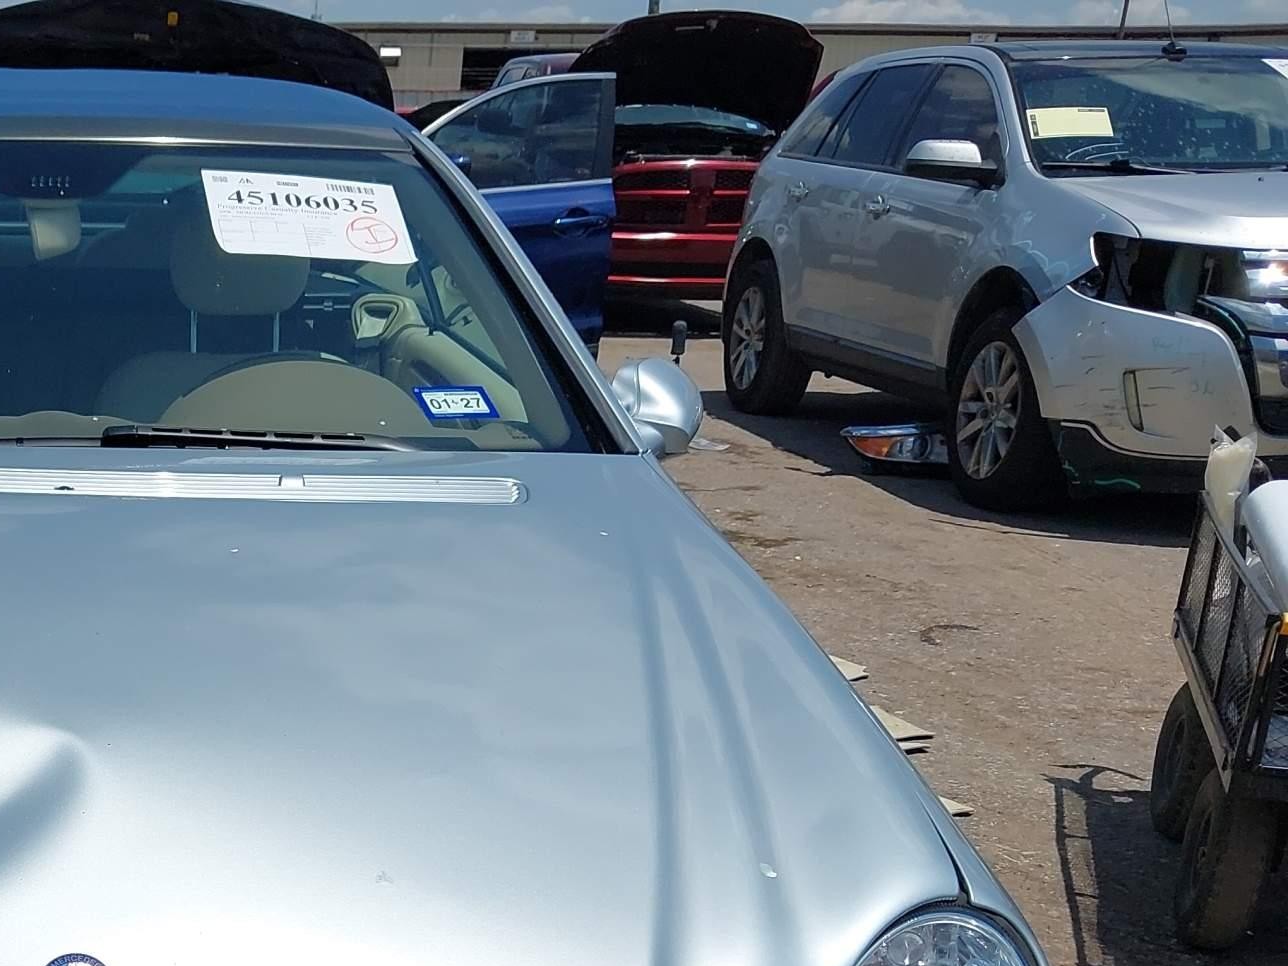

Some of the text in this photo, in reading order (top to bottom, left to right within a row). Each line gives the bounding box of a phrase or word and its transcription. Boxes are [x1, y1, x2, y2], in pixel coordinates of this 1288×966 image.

[227, 189, 378, 215] 45106035
[429, 397, 481, 410] 01 27
